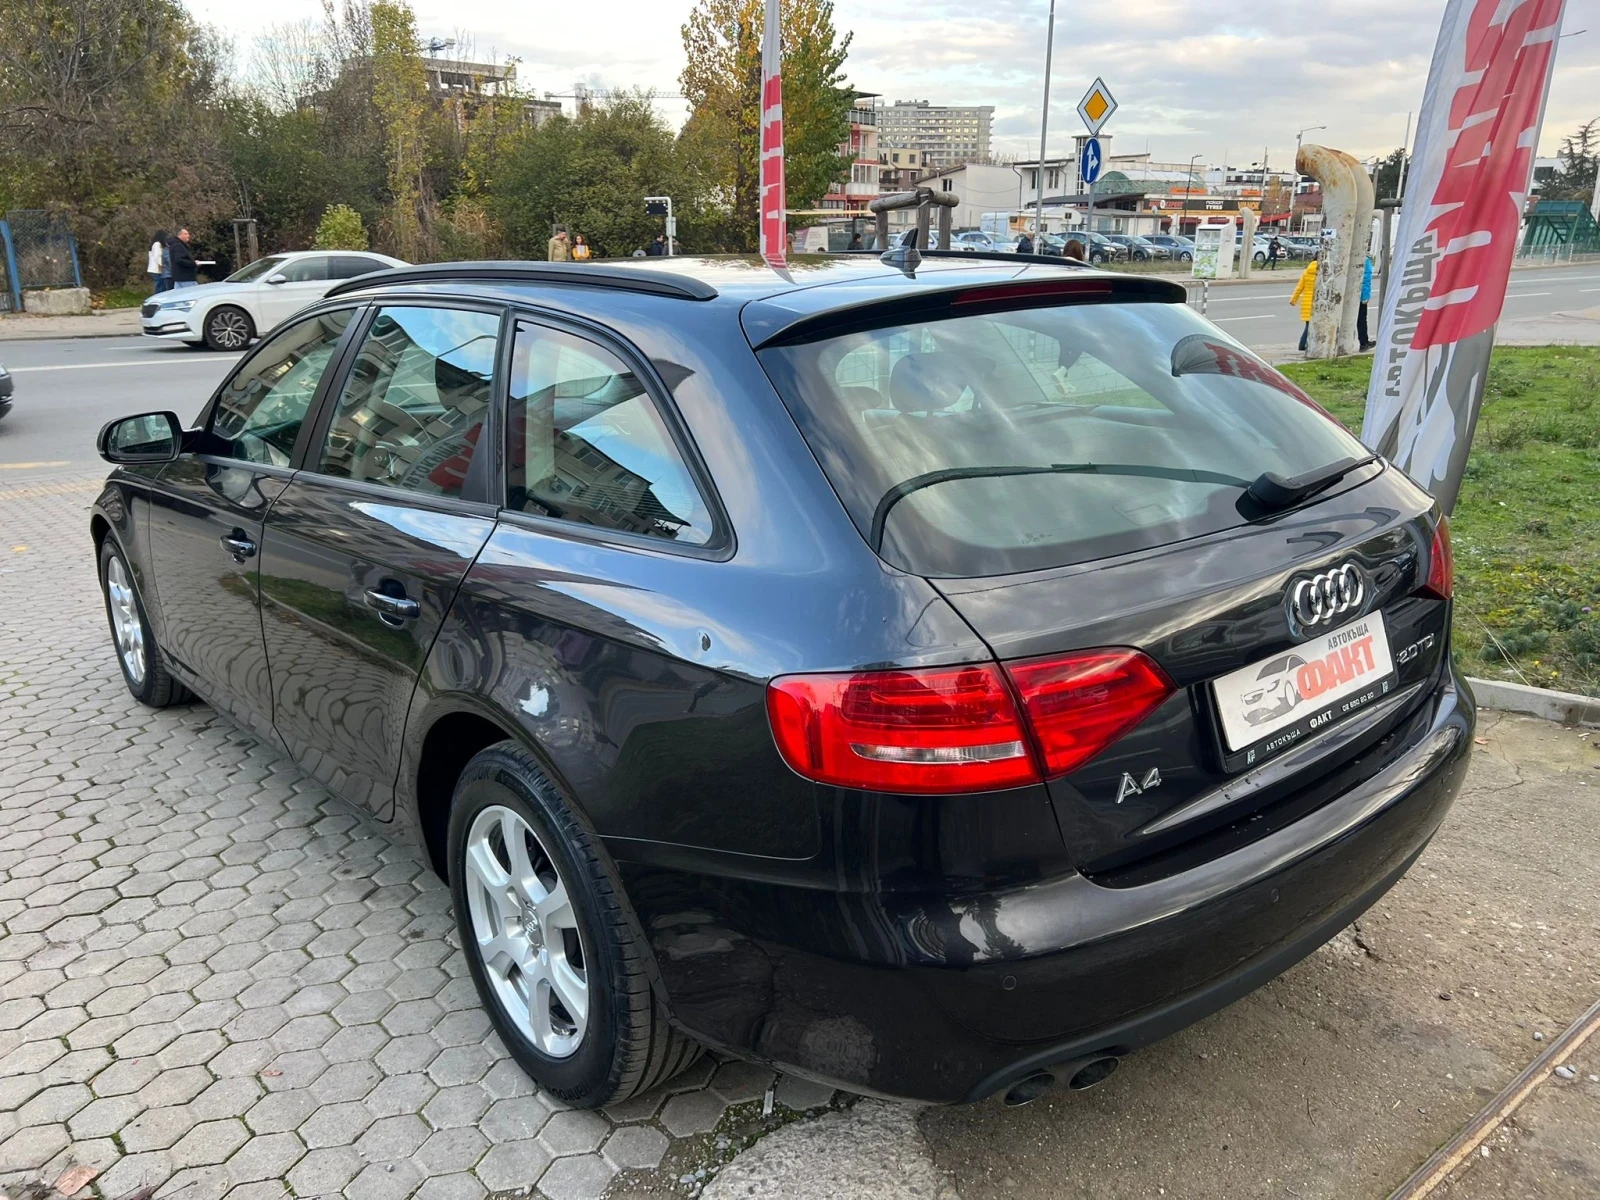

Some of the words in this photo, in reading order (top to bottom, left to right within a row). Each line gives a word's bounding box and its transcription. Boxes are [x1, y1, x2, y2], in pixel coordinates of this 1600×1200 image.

[1327, 623, 1369, 650] АВТОКЪЩА
[1296, 635, 1376, 701] ФАКТ
[1266, 729, 1301, 752] АВТОКЪЩА
[1309, 710, 1333, 729] ФАКТ
[1360, 694, 1367, 703] 20
[1366, 691, 1374, 700] 20
[1115, 767, 1162, 804] A4
